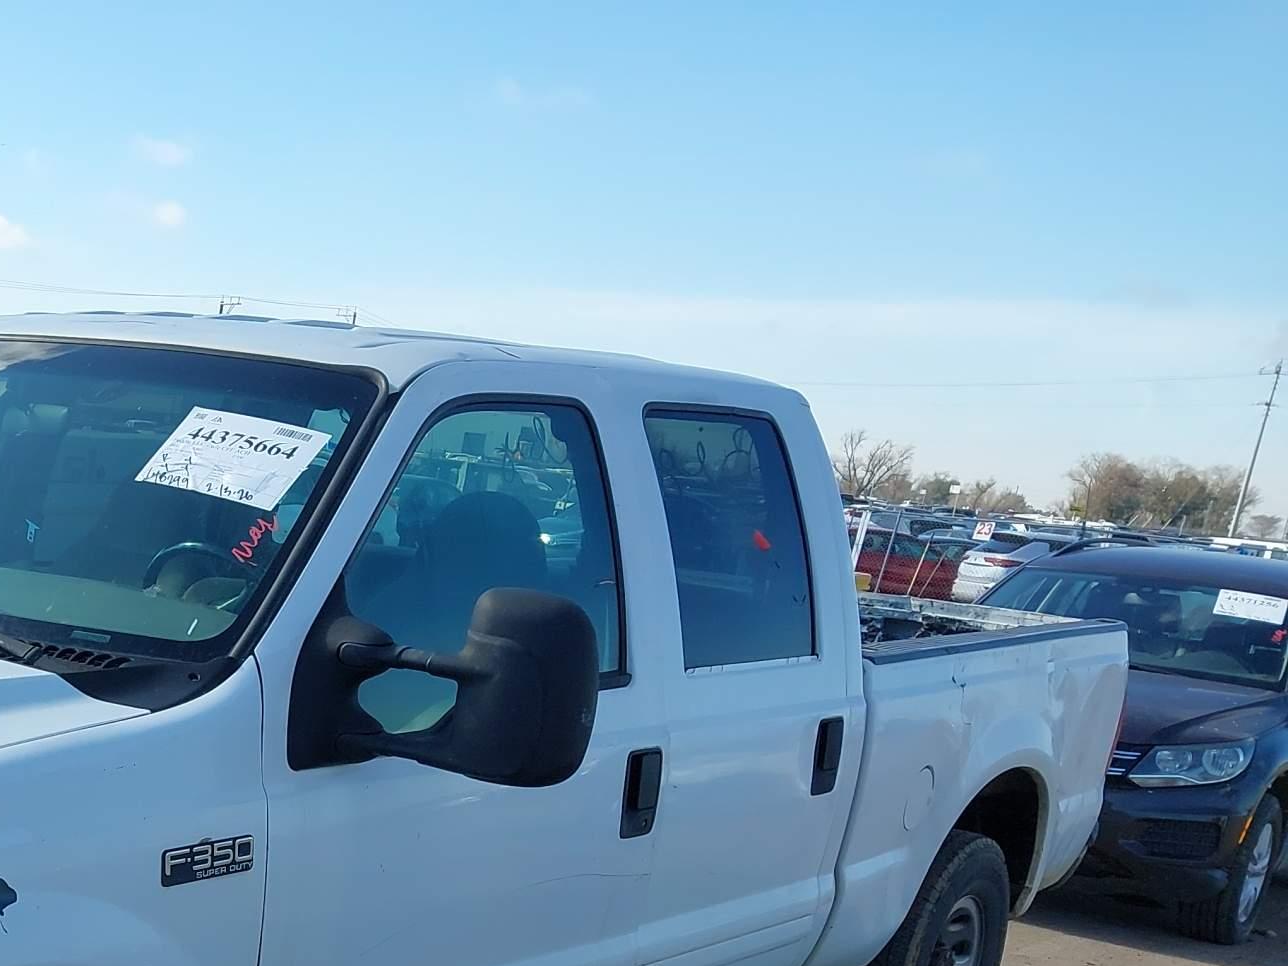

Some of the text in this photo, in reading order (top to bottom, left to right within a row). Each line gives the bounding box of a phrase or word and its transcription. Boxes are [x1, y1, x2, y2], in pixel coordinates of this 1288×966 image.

[187, 426, 299, 460] 44375664
[976, 522, 993, 536] 23
[196, 861, 253, 879] SUPER DUTY
